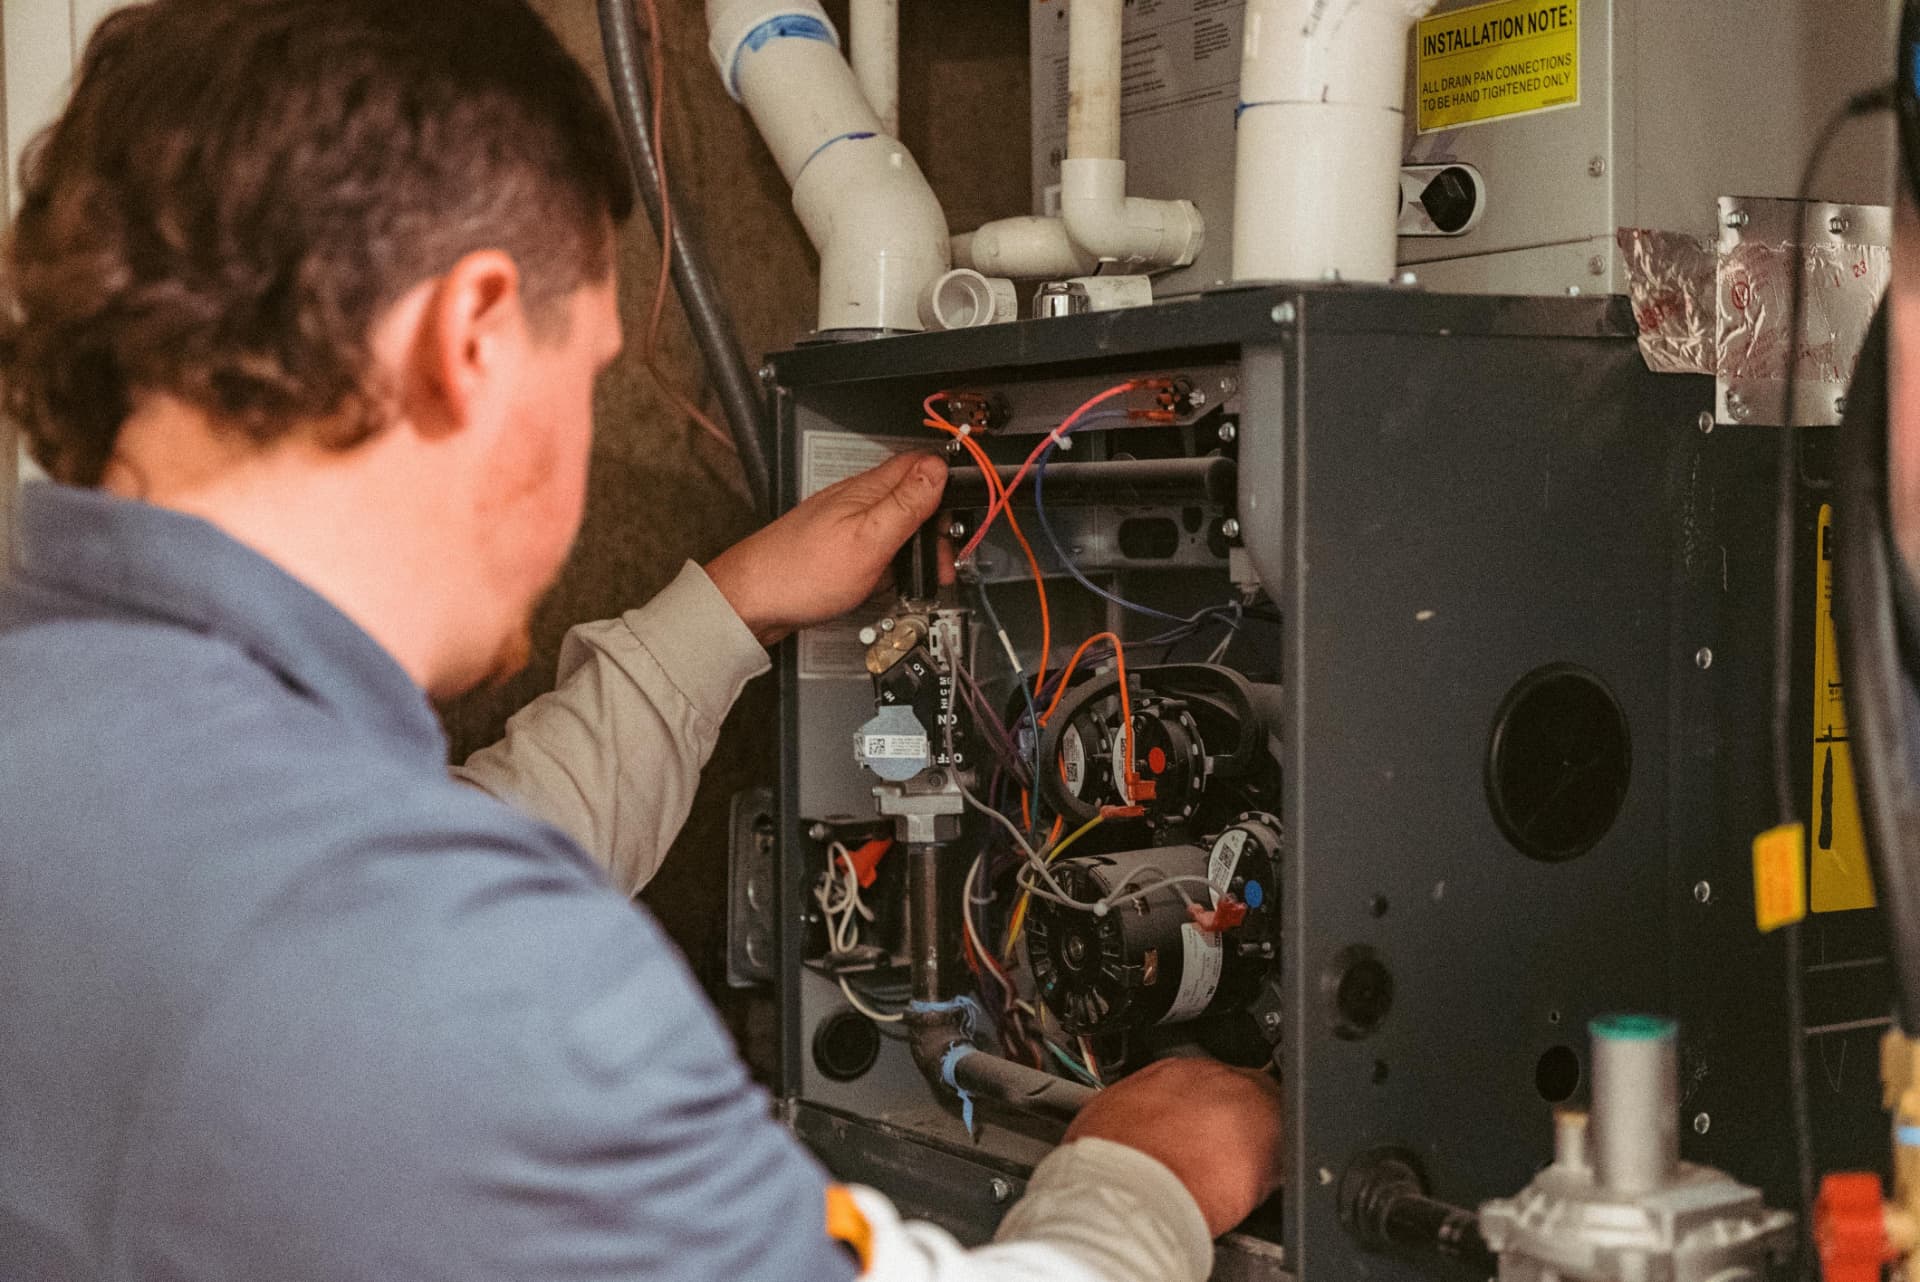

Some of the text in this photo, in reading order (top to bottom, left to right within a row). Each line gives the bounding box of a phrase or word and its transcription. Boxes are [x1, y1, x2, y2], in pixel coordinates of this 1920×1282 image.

[1423, 5, 1573, 57] INSTALLATION NOTE:
[1422, 53, 1572, 95] ALL DRAIN PAN CONNECTIONS
[1422, 71, 1571, 112] TO BE HAND TIGHTENED ONLY
